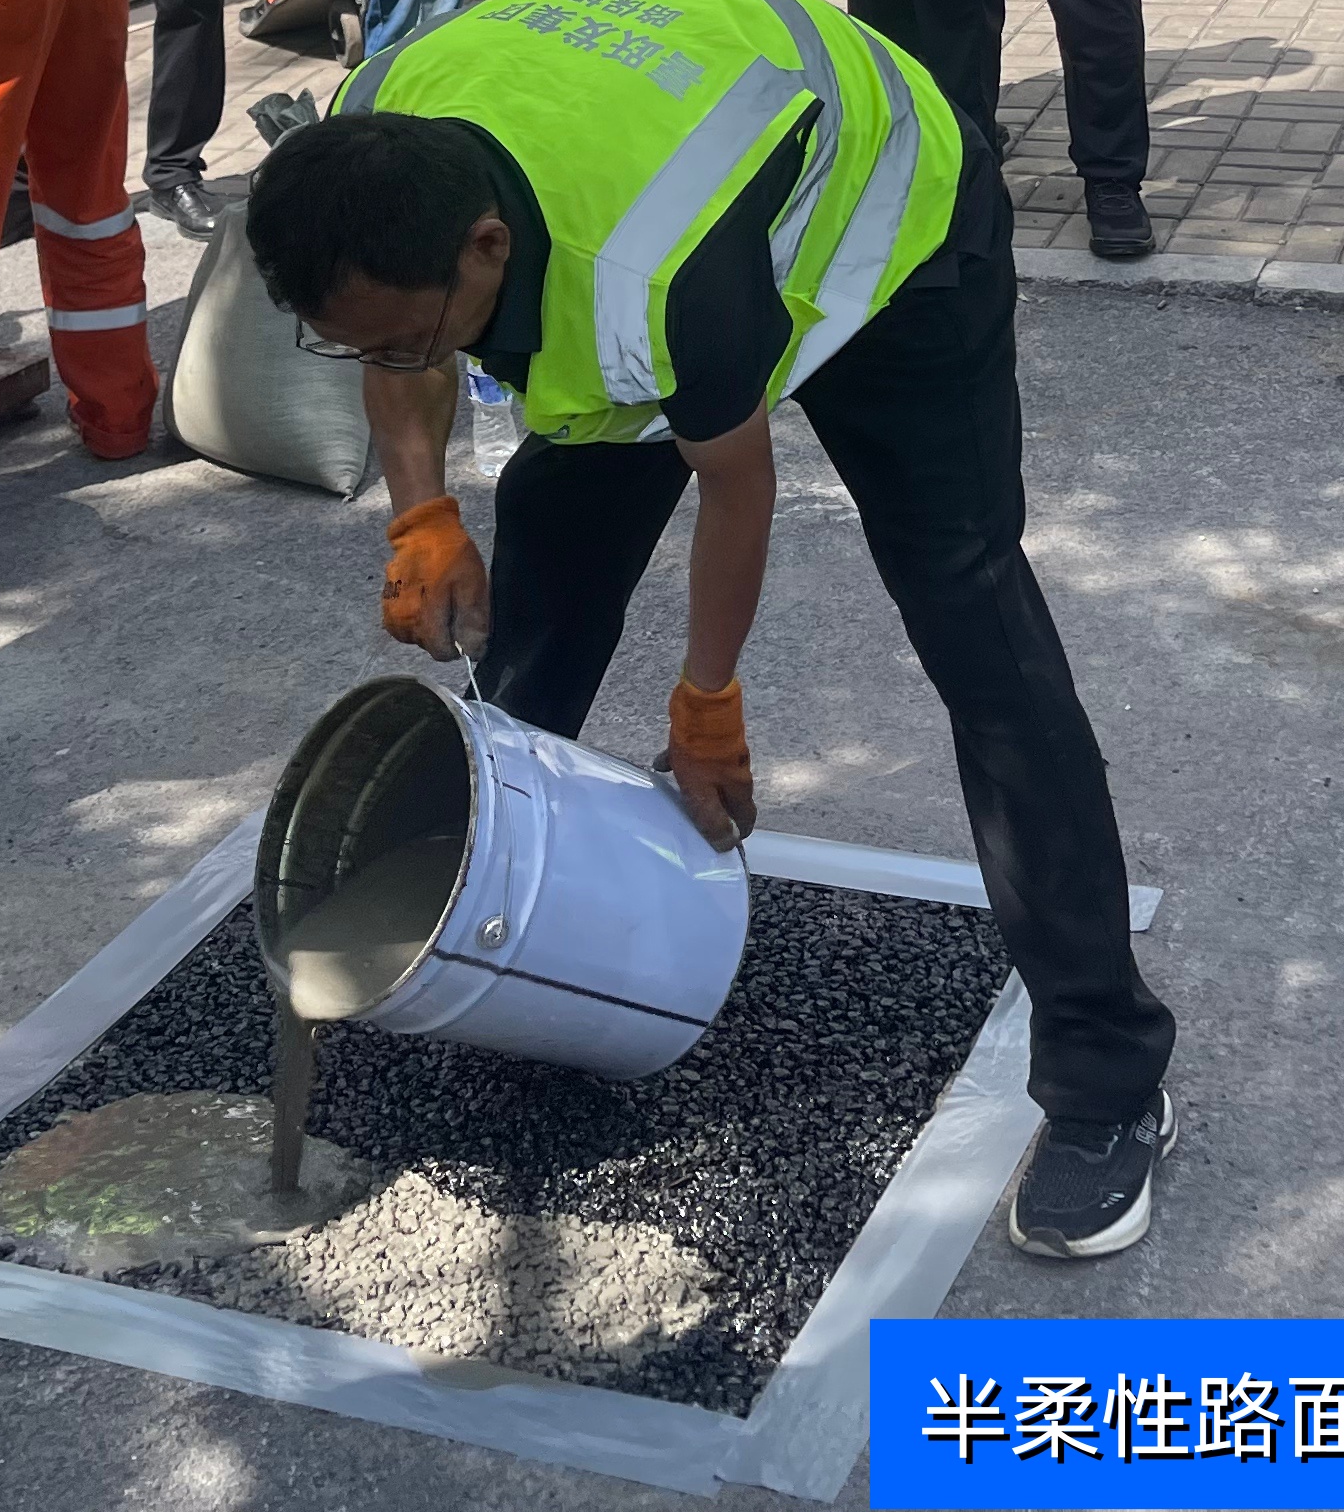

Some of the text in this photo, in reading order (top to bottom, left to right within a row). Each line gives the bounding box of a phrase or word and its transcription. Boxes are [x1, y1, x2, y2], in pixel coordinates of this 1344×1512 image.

[476, 1, 706, 102] 喜跃发集团
